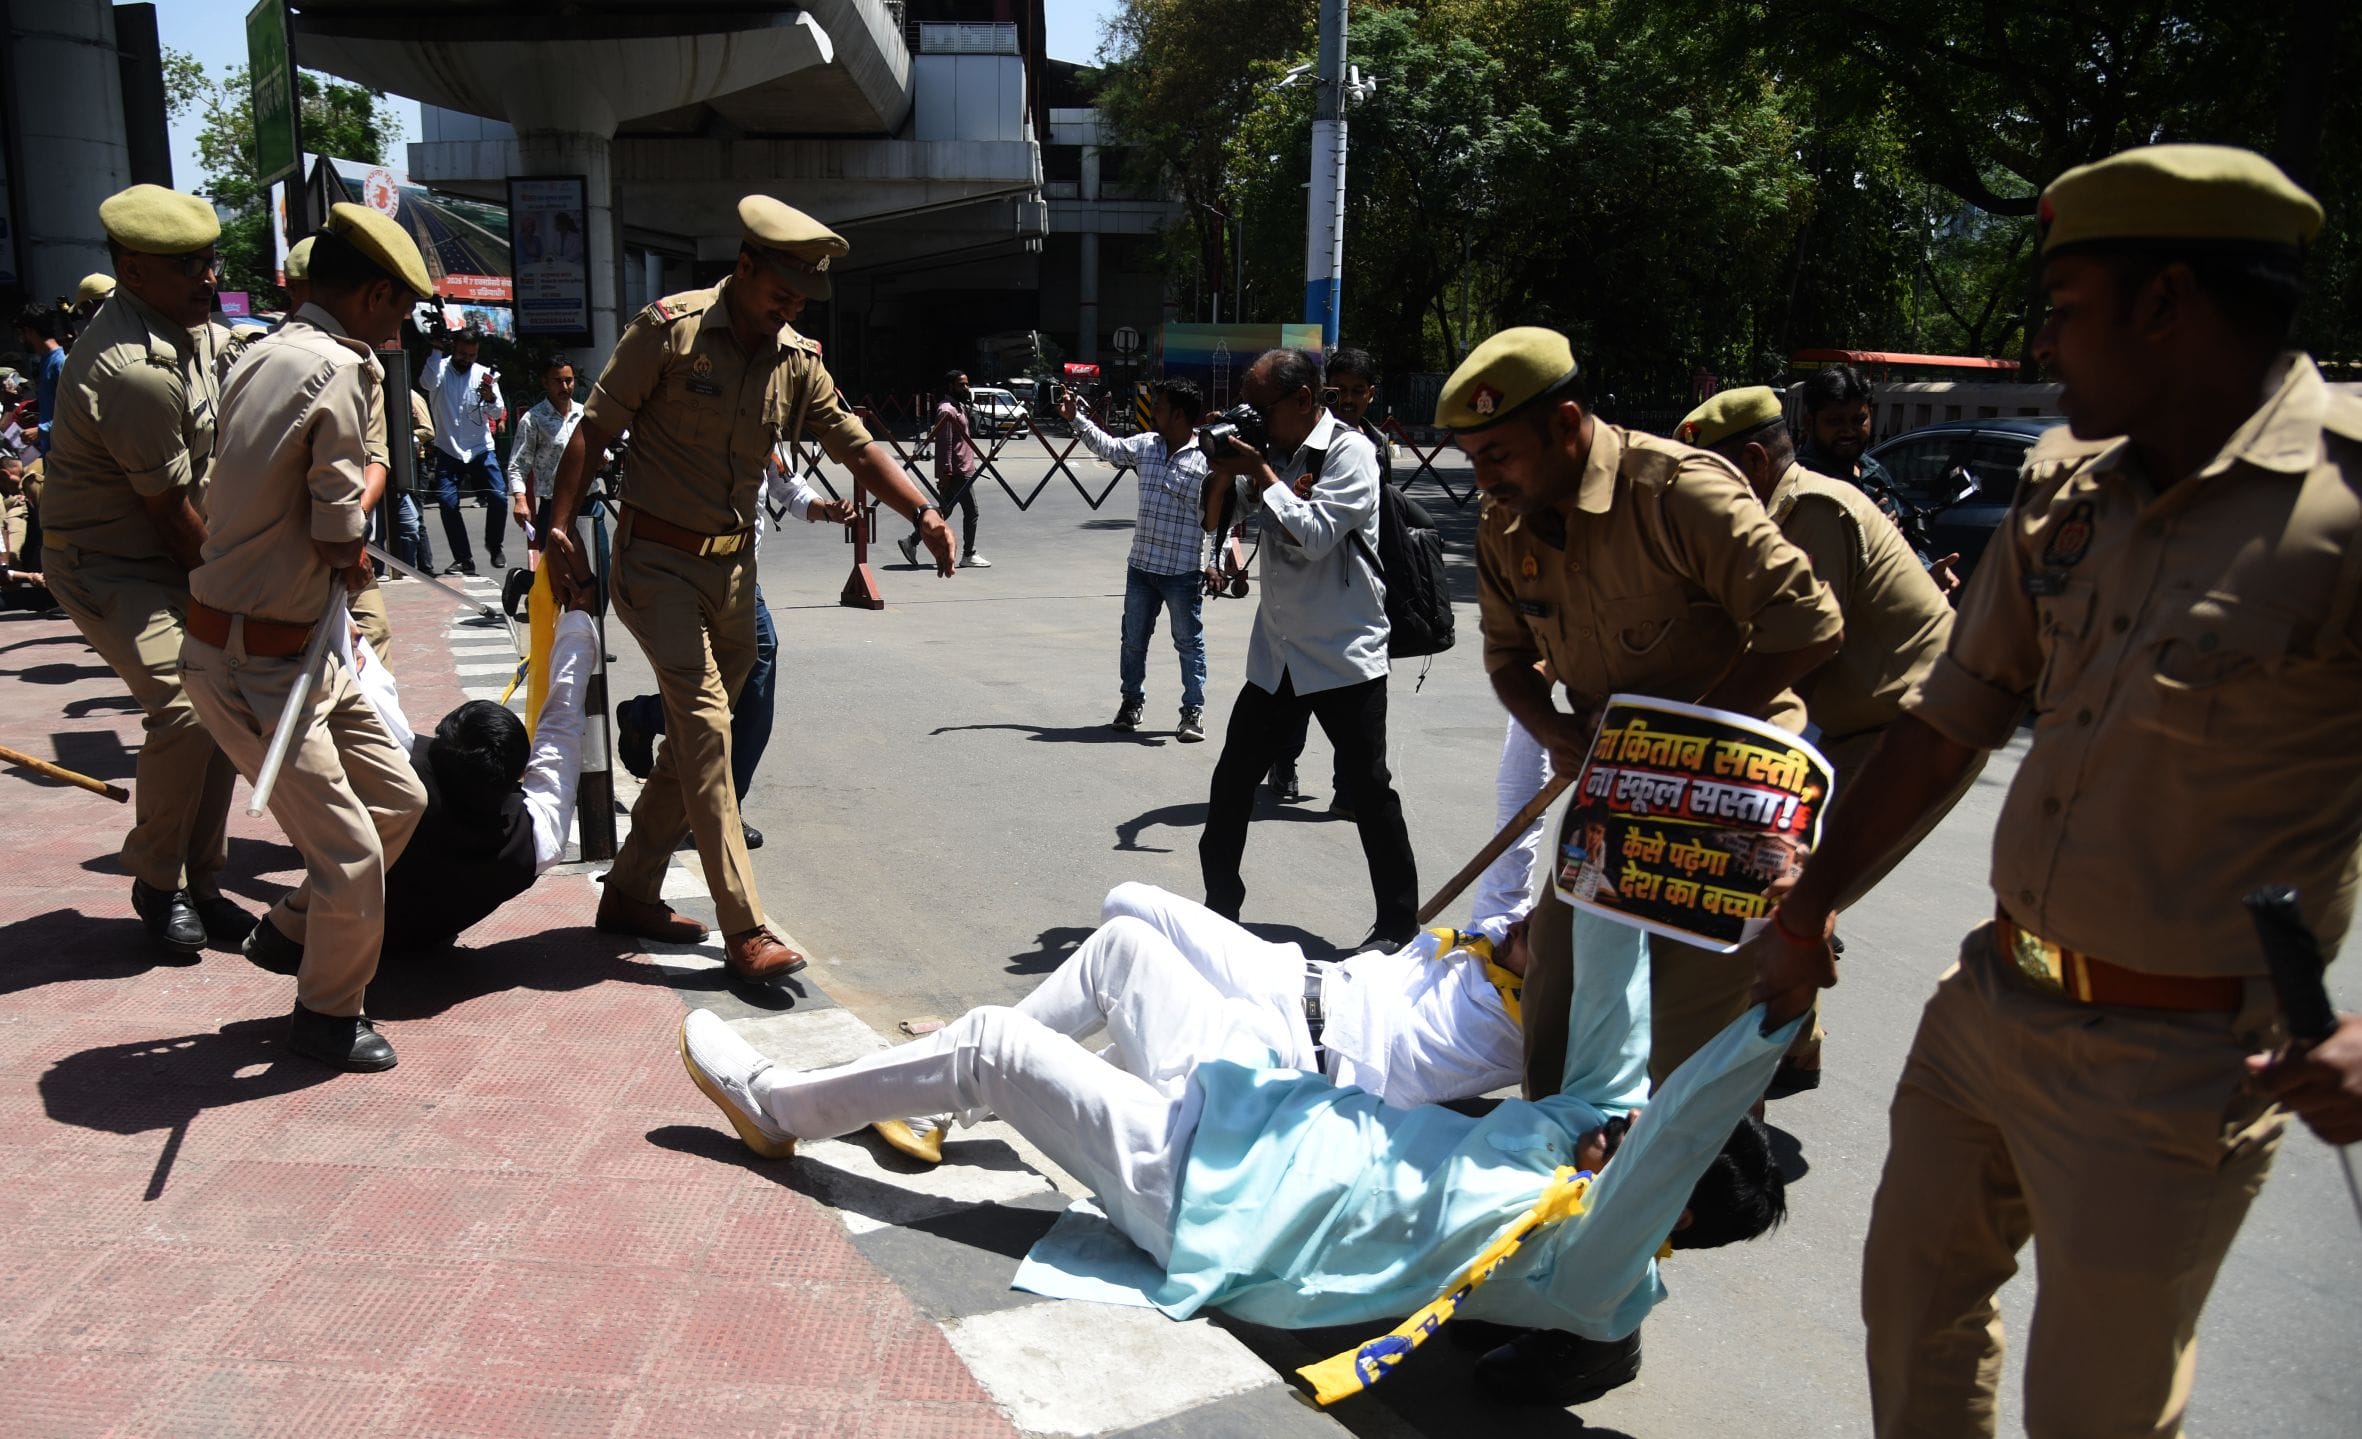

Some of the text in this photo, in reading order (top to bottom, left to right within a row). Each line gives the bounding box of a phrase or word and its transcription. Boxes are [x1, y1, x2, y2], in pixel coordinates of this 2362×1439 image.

[1595, 719, 1813, 804] ना किताब सस्ती,
[1586, 768, 1800, 829] ना स्कूल सस्ता!
[1621, 826, 1667, 864] कैसे
[1668, 838, 1731, 877] पढ़ेगा
[1619, 860, 1664, 900] देश
[1664, 876, 1701, 909] का
[1702, 884, 1780, 920] बच्चा
